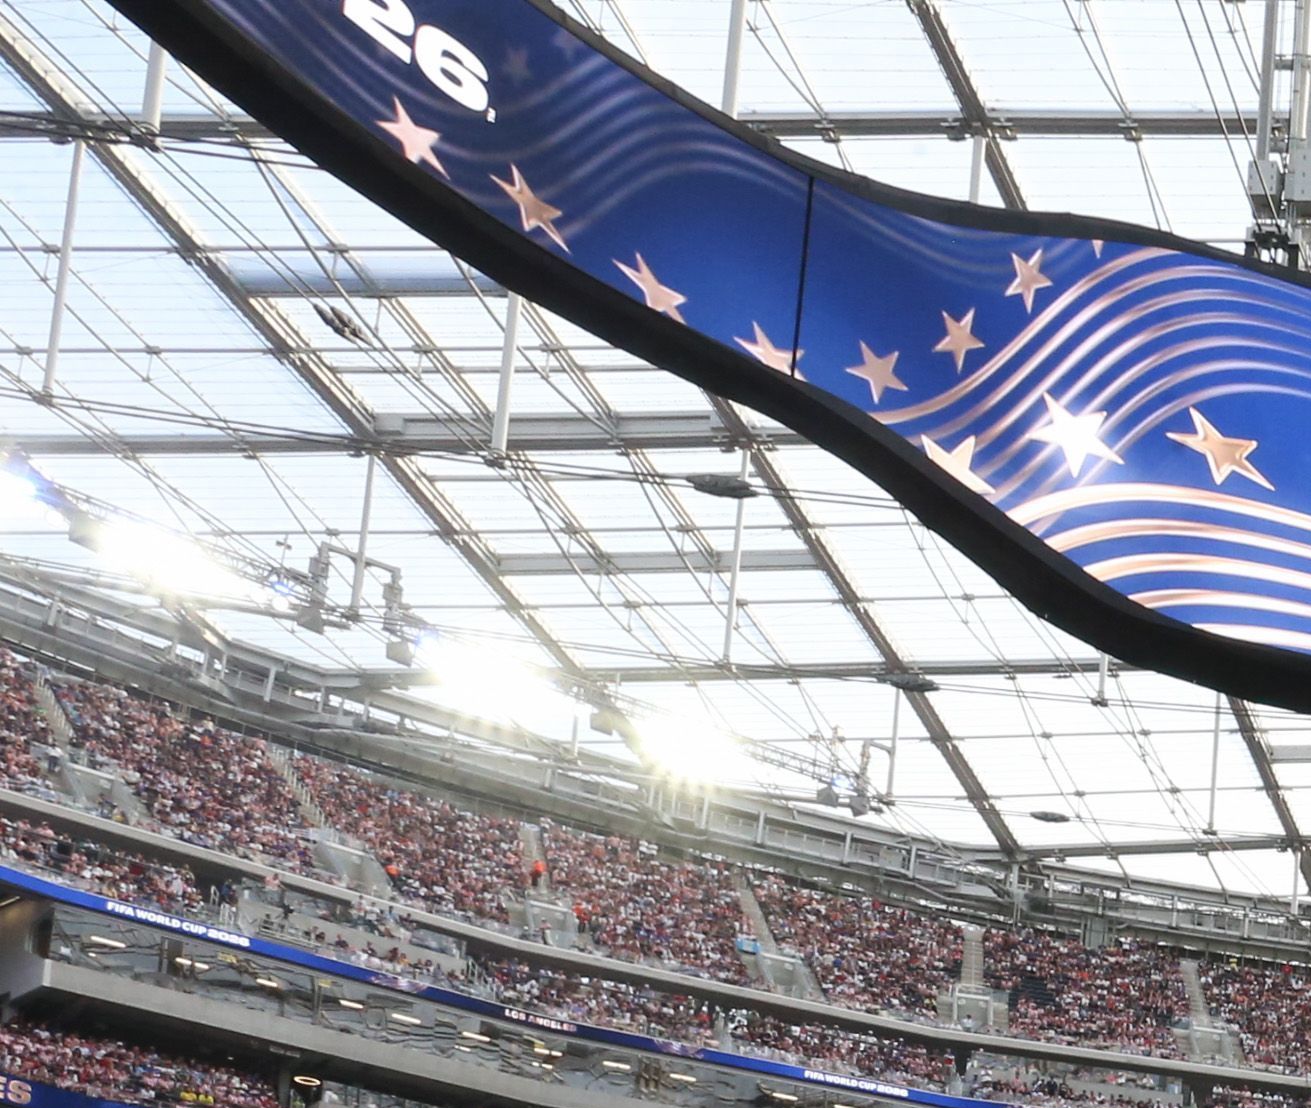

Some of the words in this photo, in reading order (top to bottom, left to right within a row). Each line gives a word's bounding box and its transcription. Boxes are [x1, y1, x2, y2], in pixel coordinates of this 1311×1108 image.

[107, 901, 134, 917] FIFA
[136, 909, 181, 928] WORLD
[182, 922, 207, 935] CUP
[804, 1070, 823, 1082] FIFA
[825, 1074, 857, 1088] WORLD
[858, 1079, 877, 1091] CUP
